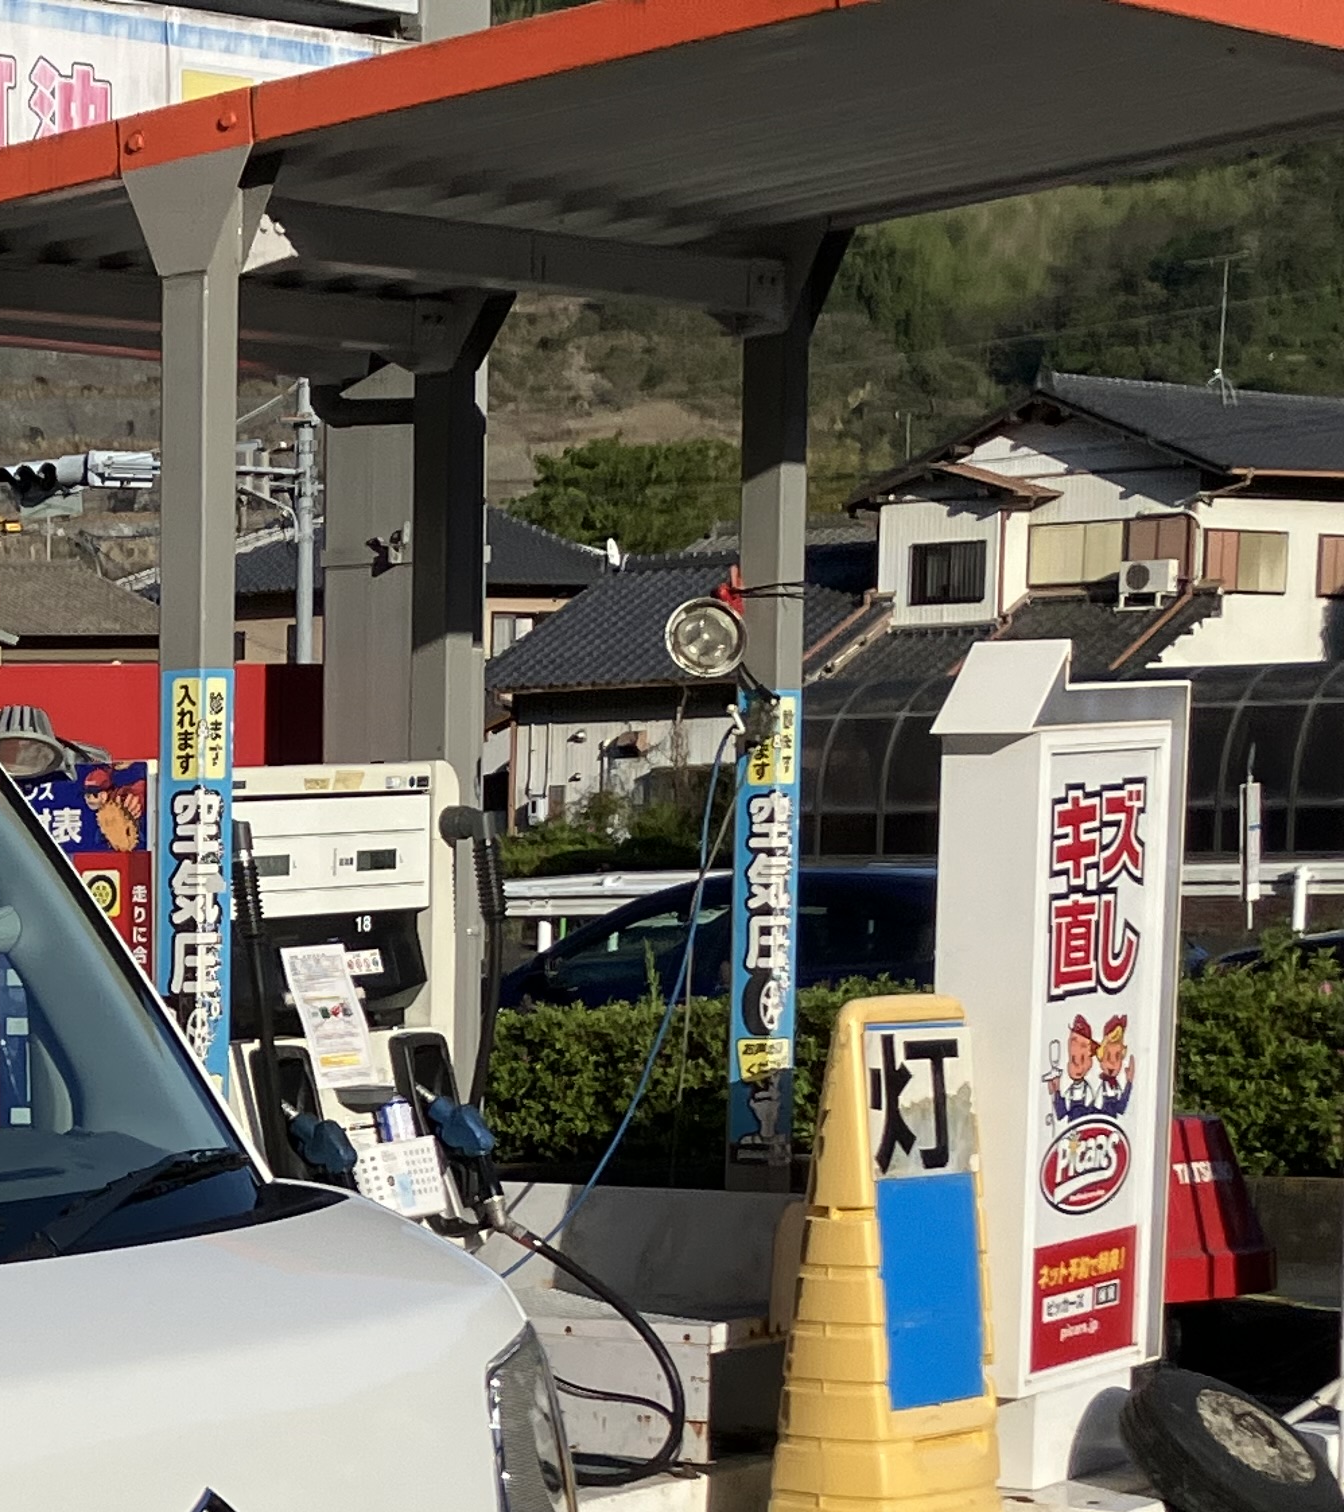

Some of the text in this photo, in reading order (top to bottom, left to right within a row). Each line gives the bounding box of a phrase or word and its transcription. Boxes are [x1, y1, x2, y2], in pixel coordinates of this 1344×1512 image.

[176, 684, 197, 775] 入れます
[1053, 780, 1146, 885] キズ
[355, 915, 372, 932] 18
[1050, 888, 1140, 998] 直し
[868, 1033, 960, 1176] 灯
